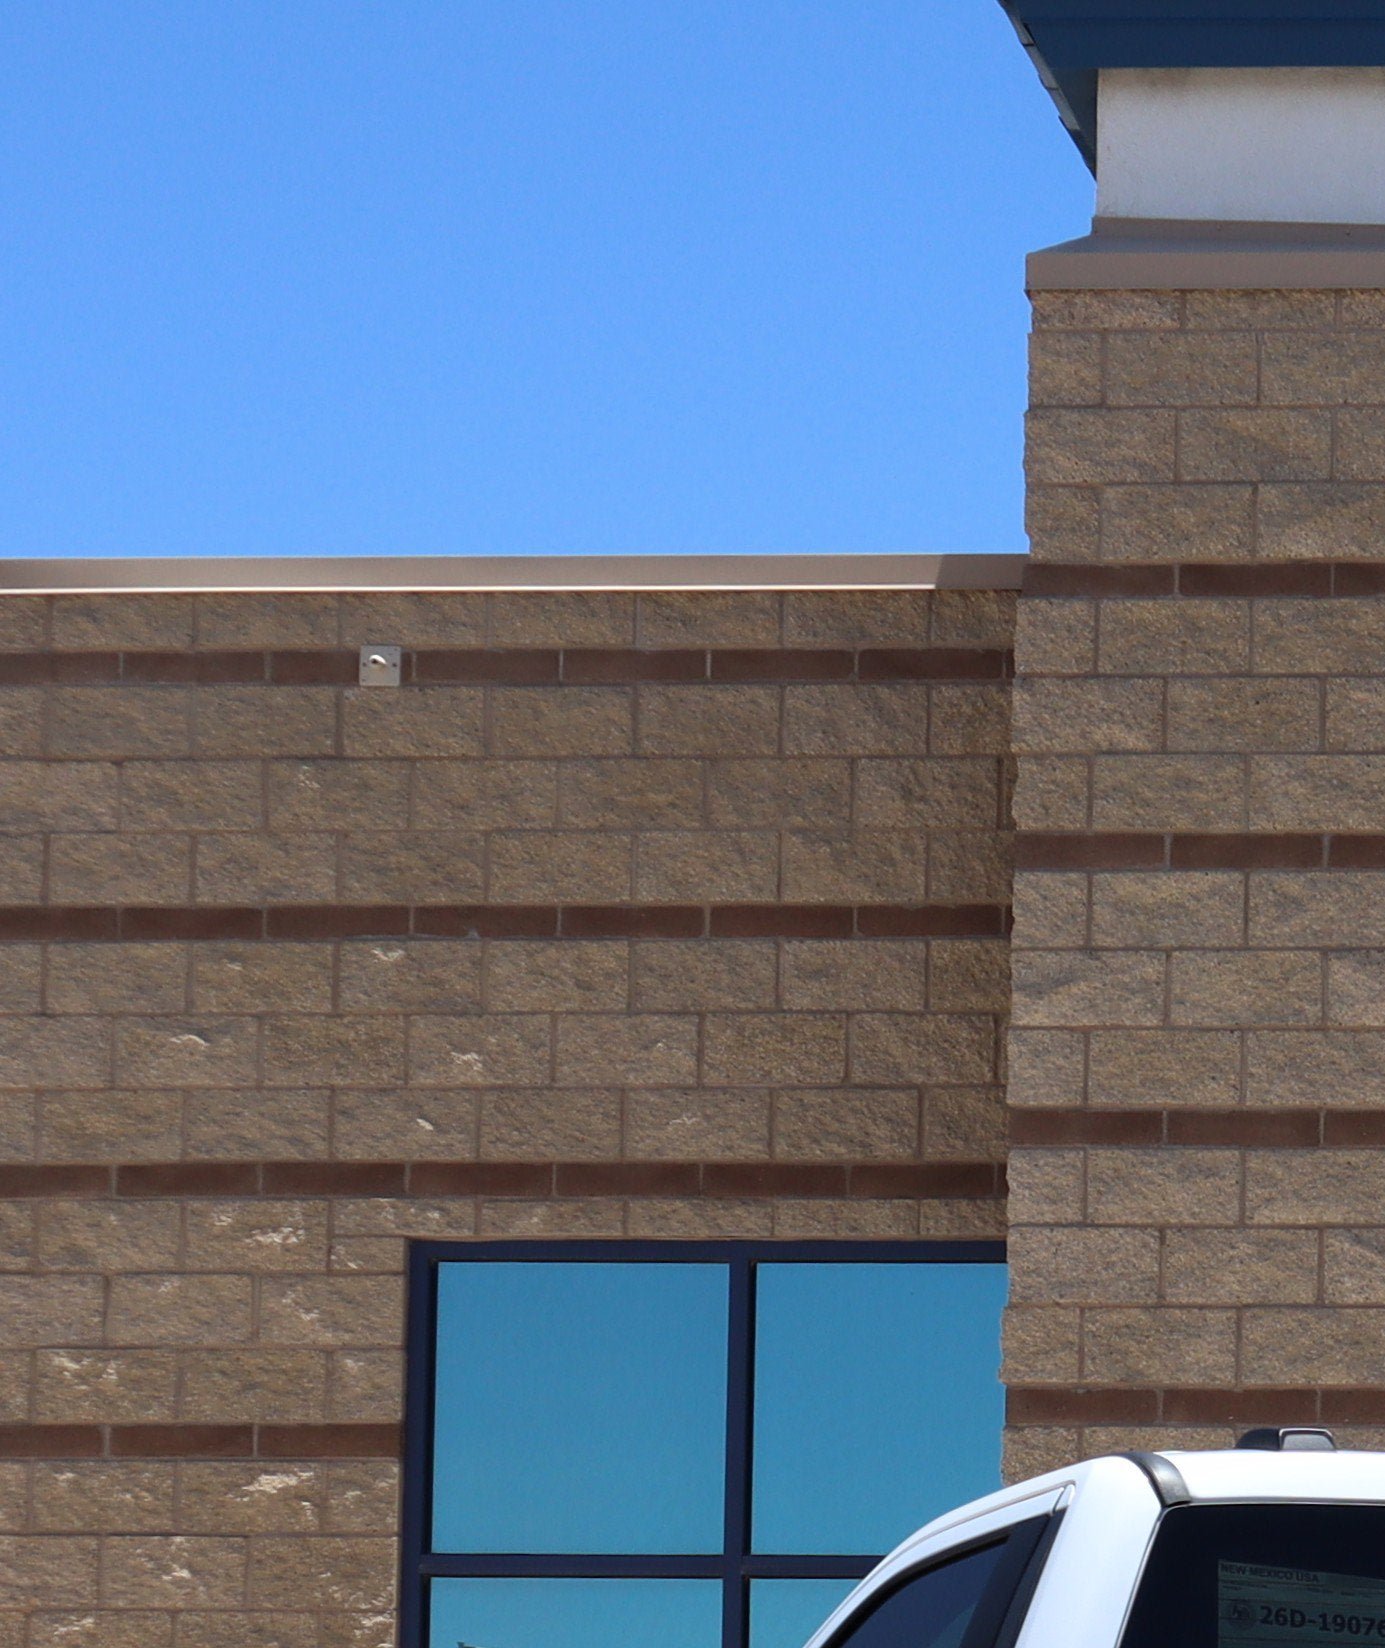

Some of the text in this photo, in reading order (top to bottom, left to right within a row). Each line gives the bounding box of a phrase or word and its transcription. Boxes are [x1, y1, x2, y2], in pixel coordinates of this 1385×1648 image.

[1220, 1563, 1320, 1583] NEW MEXICO USA
